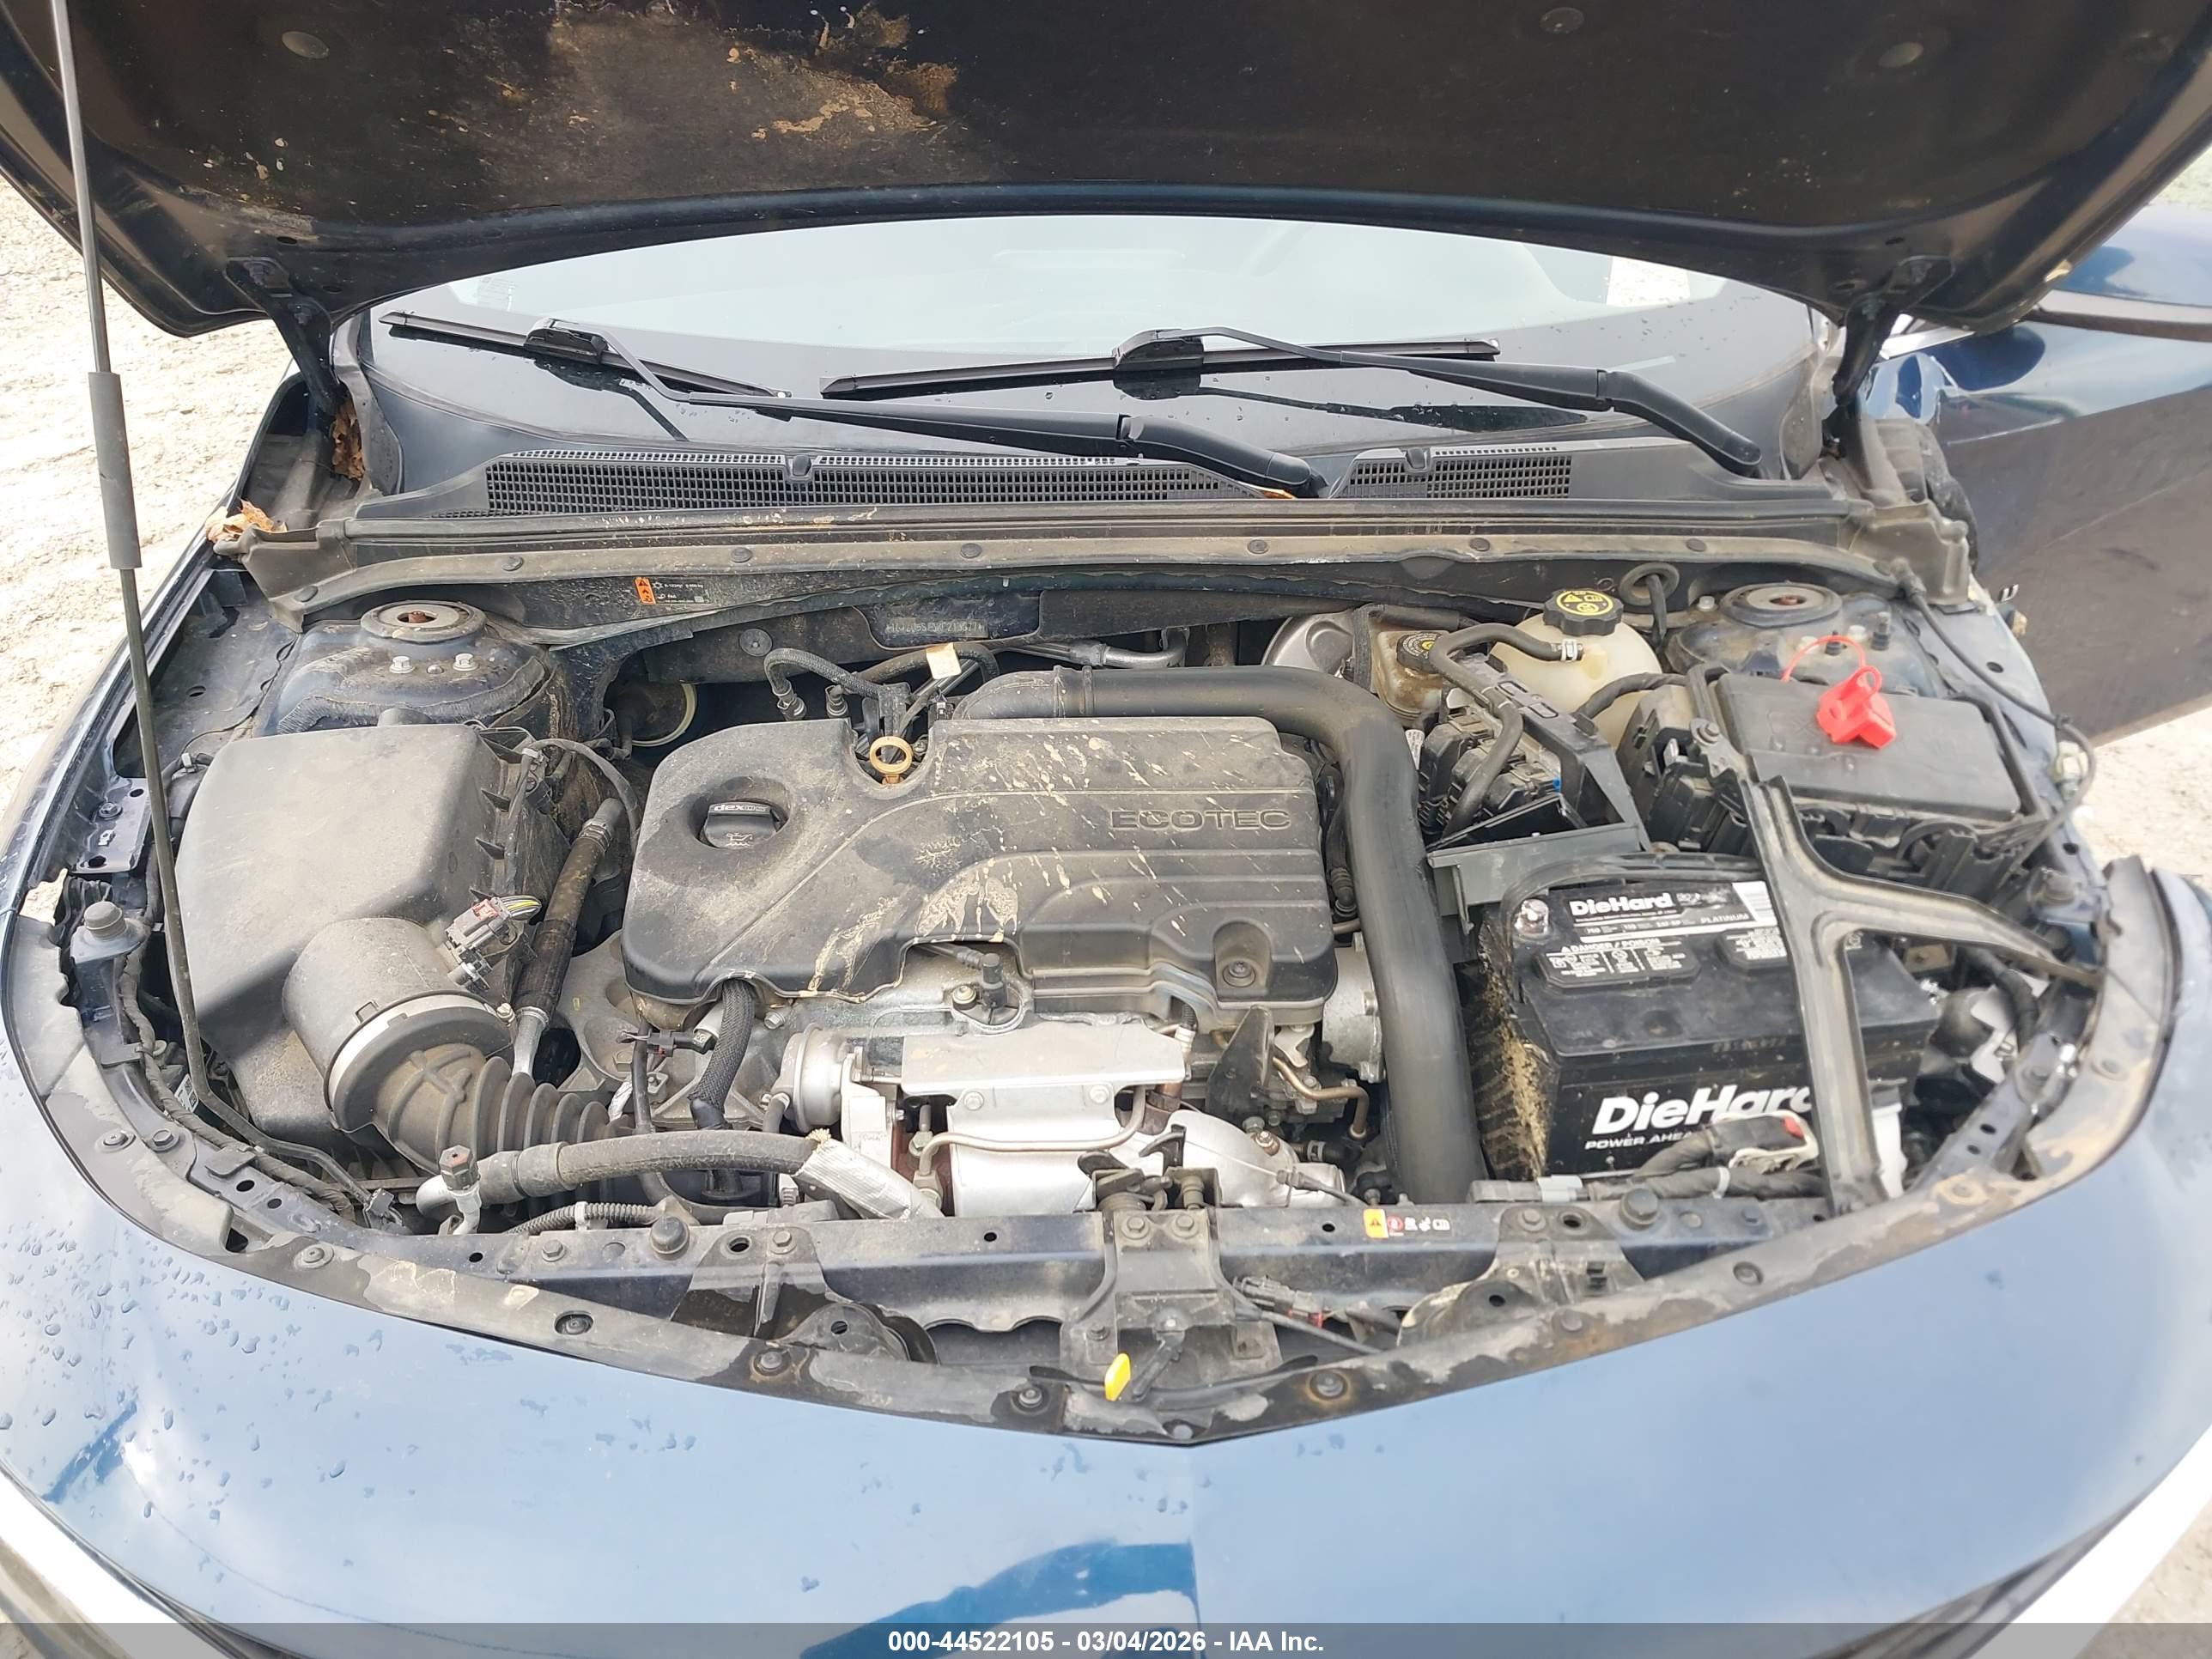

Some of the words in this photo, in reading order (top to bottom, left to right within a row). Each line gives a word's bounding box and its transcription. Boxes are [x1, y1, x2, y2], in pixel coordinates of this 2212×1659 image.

[1109, 809, 1291, 831] ECOTEC
[1569, 892, 1675, 916] DieHard
[1700, 913, 1750, 925] PLATINUM
[1571, 942, 1613, 952] DANGER
[1584, 1135, 1646, 1151] POWER
